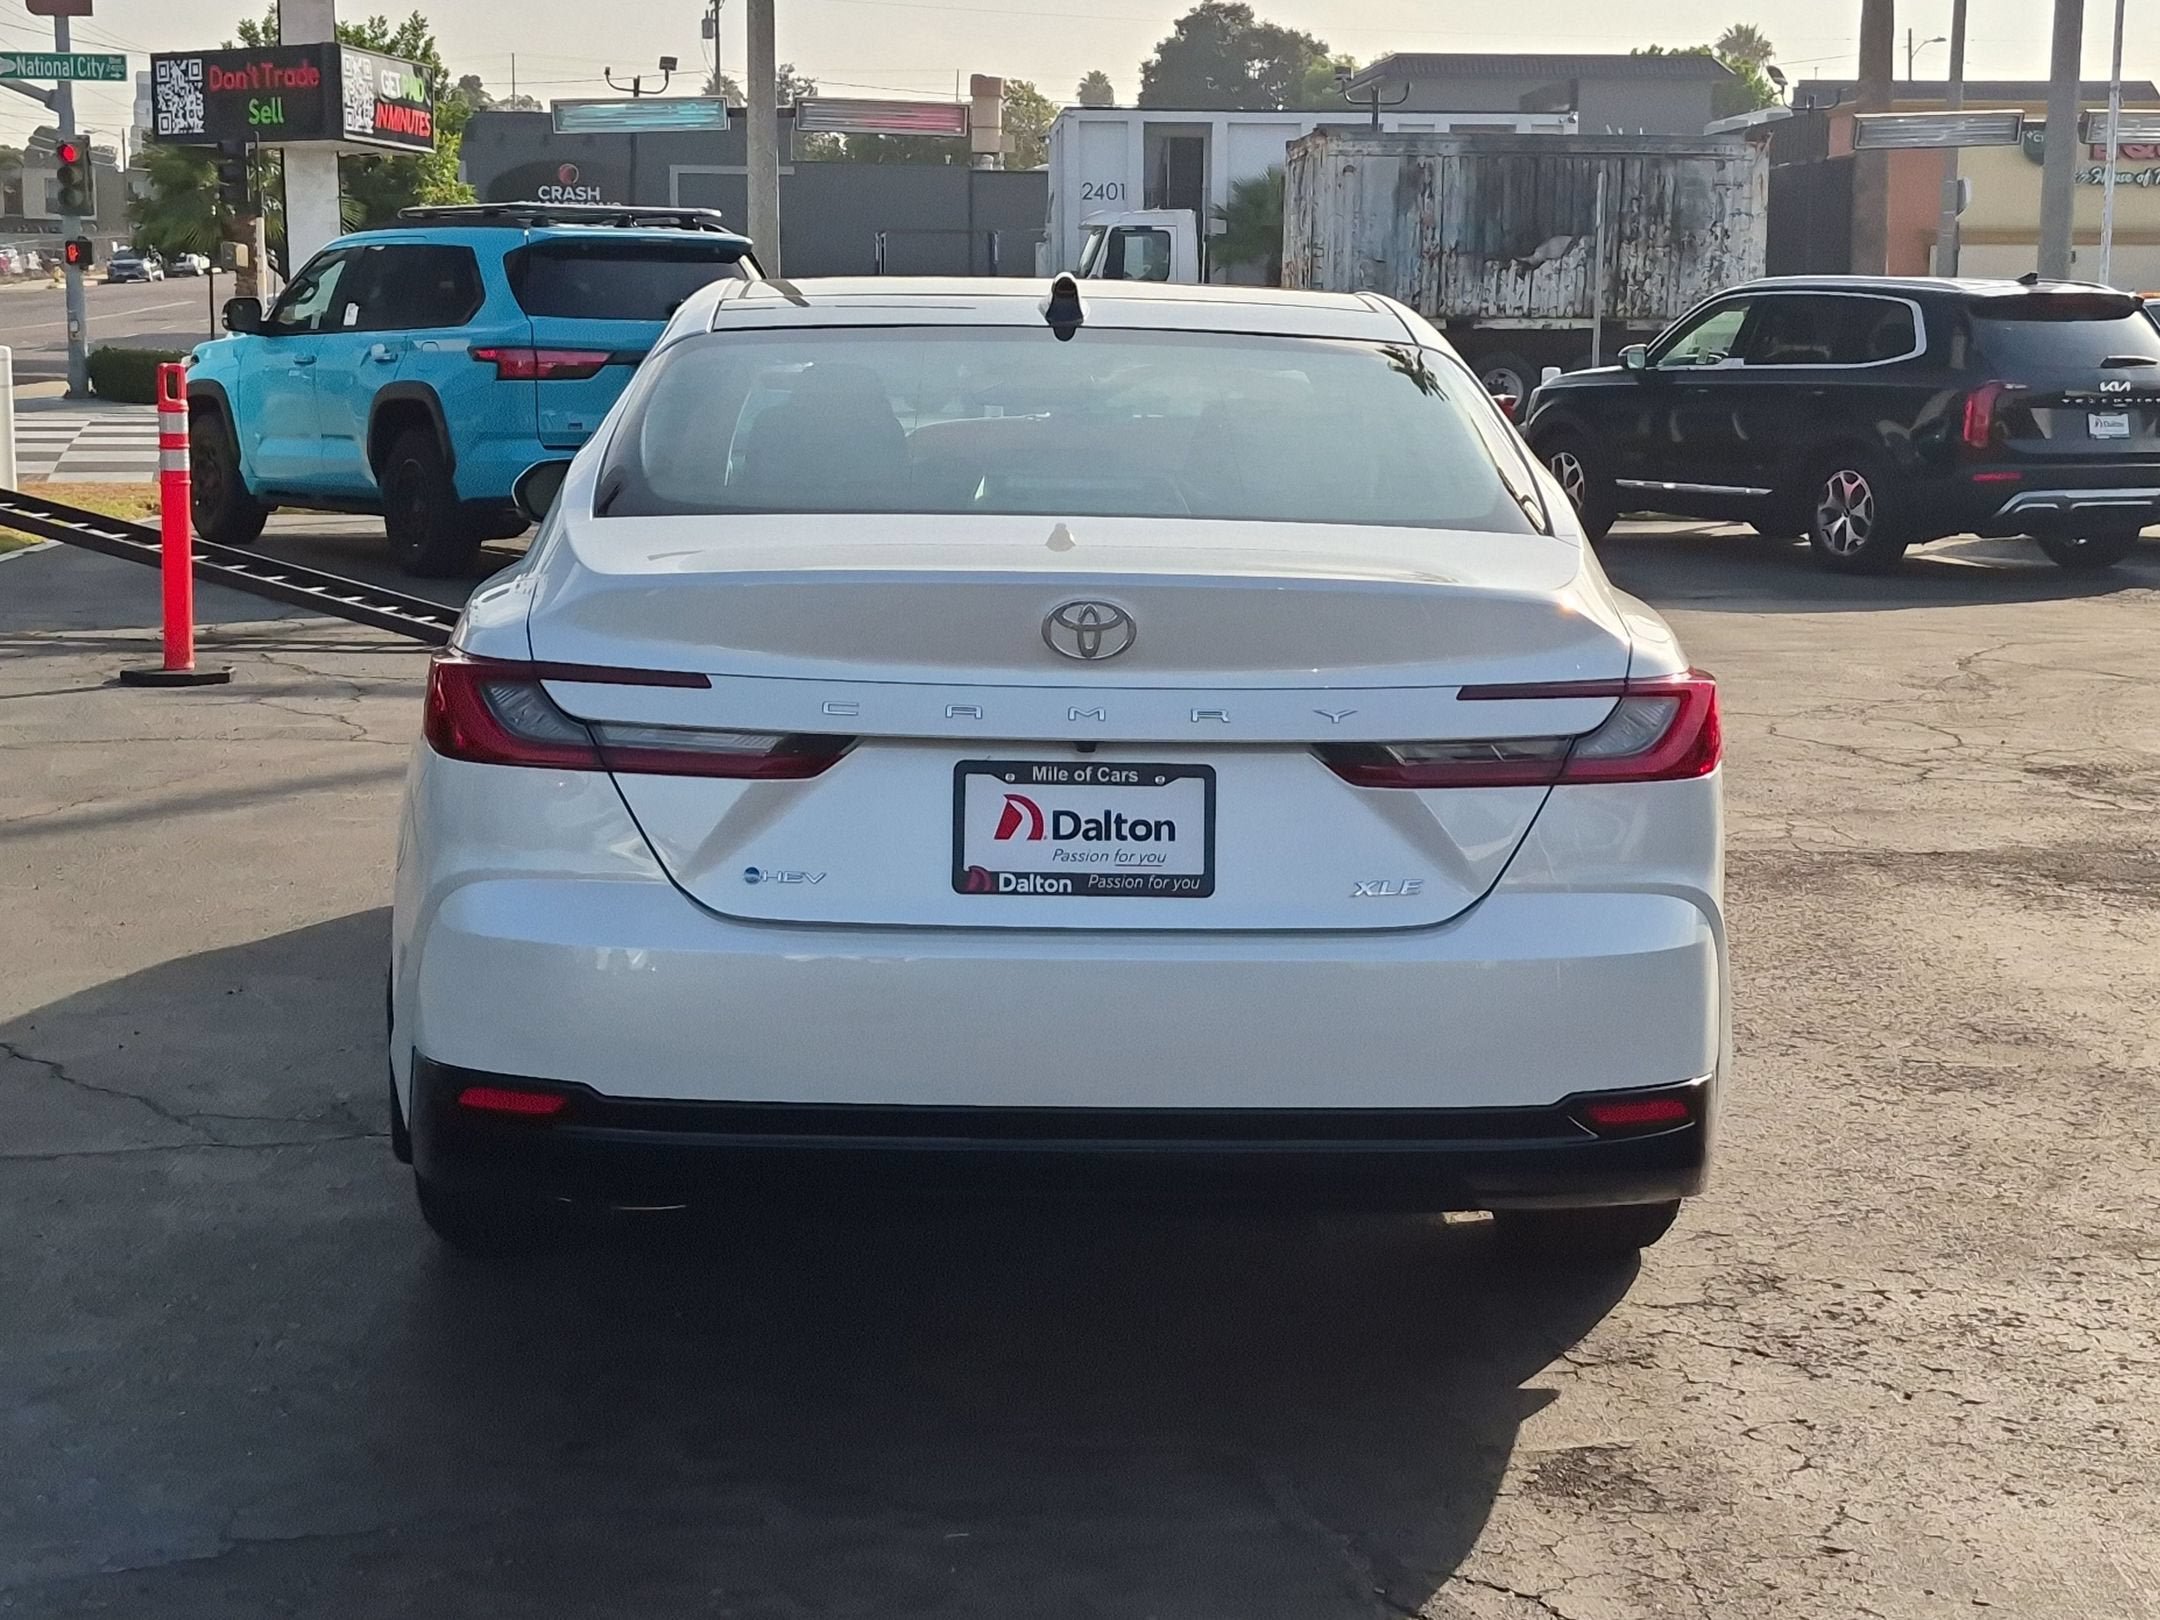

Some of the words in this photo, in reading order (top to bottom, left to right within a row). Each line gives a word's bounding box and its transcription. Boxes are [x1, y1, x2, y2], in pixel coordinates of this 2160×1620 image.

[16, 56, 74, 76] National
[77, 57, 106, 78] City
[208, 62, 260, 92] Don't
[261, 59, 321, 88] Trade
[381, 69, 401, 100] GET
[401, 74, 425, 103] PAID
[249, 97, 284, 125] Sell
[388, 104, 432, 137] MINUTES
[537, 185, 600, 201] CRASH
[1081, 182, 1125, 201] 2401
[821, 701, 1358, 724] CAMRY
[1032, 766, 1069, 782] Mile
[1073, 766, 1093, 782] of
[1097, 767, 1139, 783] Cars
[1052, 809, 1176, 842] Dalton
[1052, 848, 1110, 863] Passion
[1114, 848, 1136, 865] for
[1138, 852, 1167, 866] you
[761, 869, 827, 885] HEV
[999, 873, 1072, 893] Dalton
[1087, 874, 1144, 890] Passion
[1147, 875, 1169, 891] for
[1171, 878, 1200, 893] you
[1352, 879, 1424, 897] XLE
